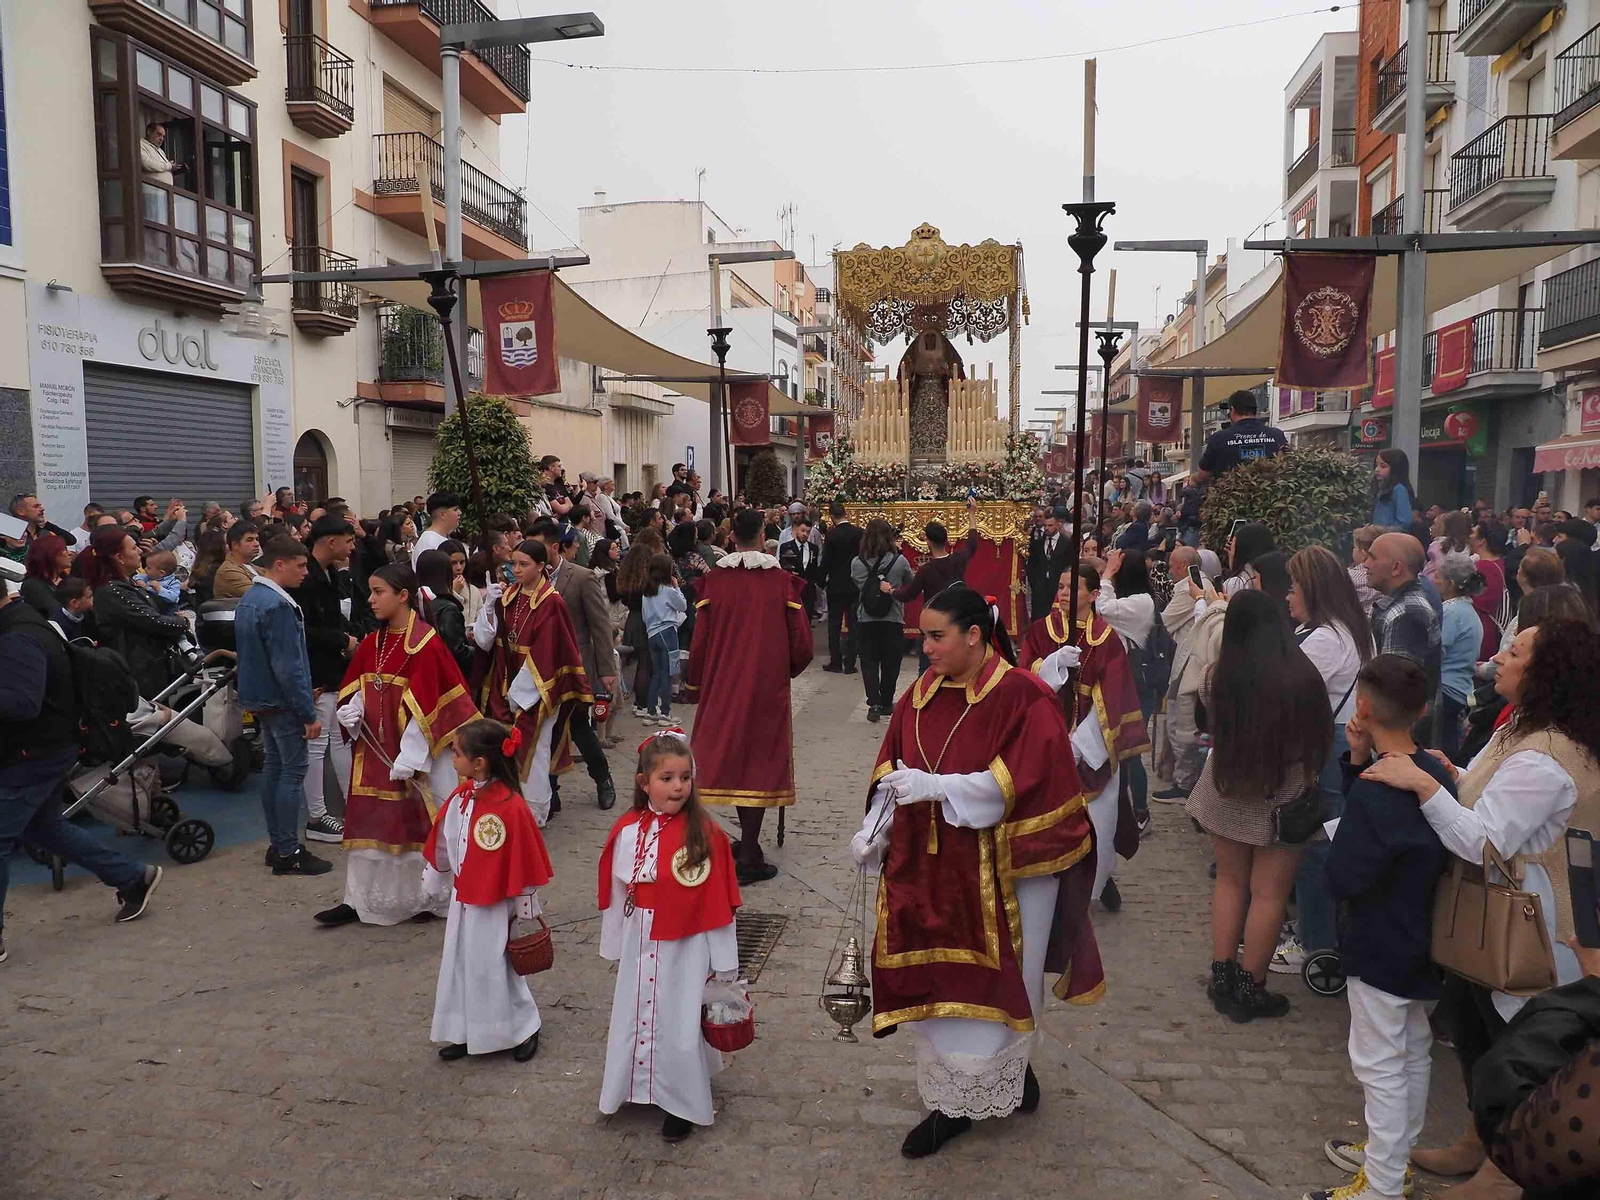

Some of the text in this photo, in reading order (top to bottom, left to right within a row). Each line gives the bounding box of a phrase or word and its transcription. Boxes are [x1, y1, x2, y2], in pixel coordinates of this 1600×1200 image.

[37, 323, 98, 343] FISIOTERAPIA
[138, 317, 219, 371] dual
[688, 448, 694, 470] P
